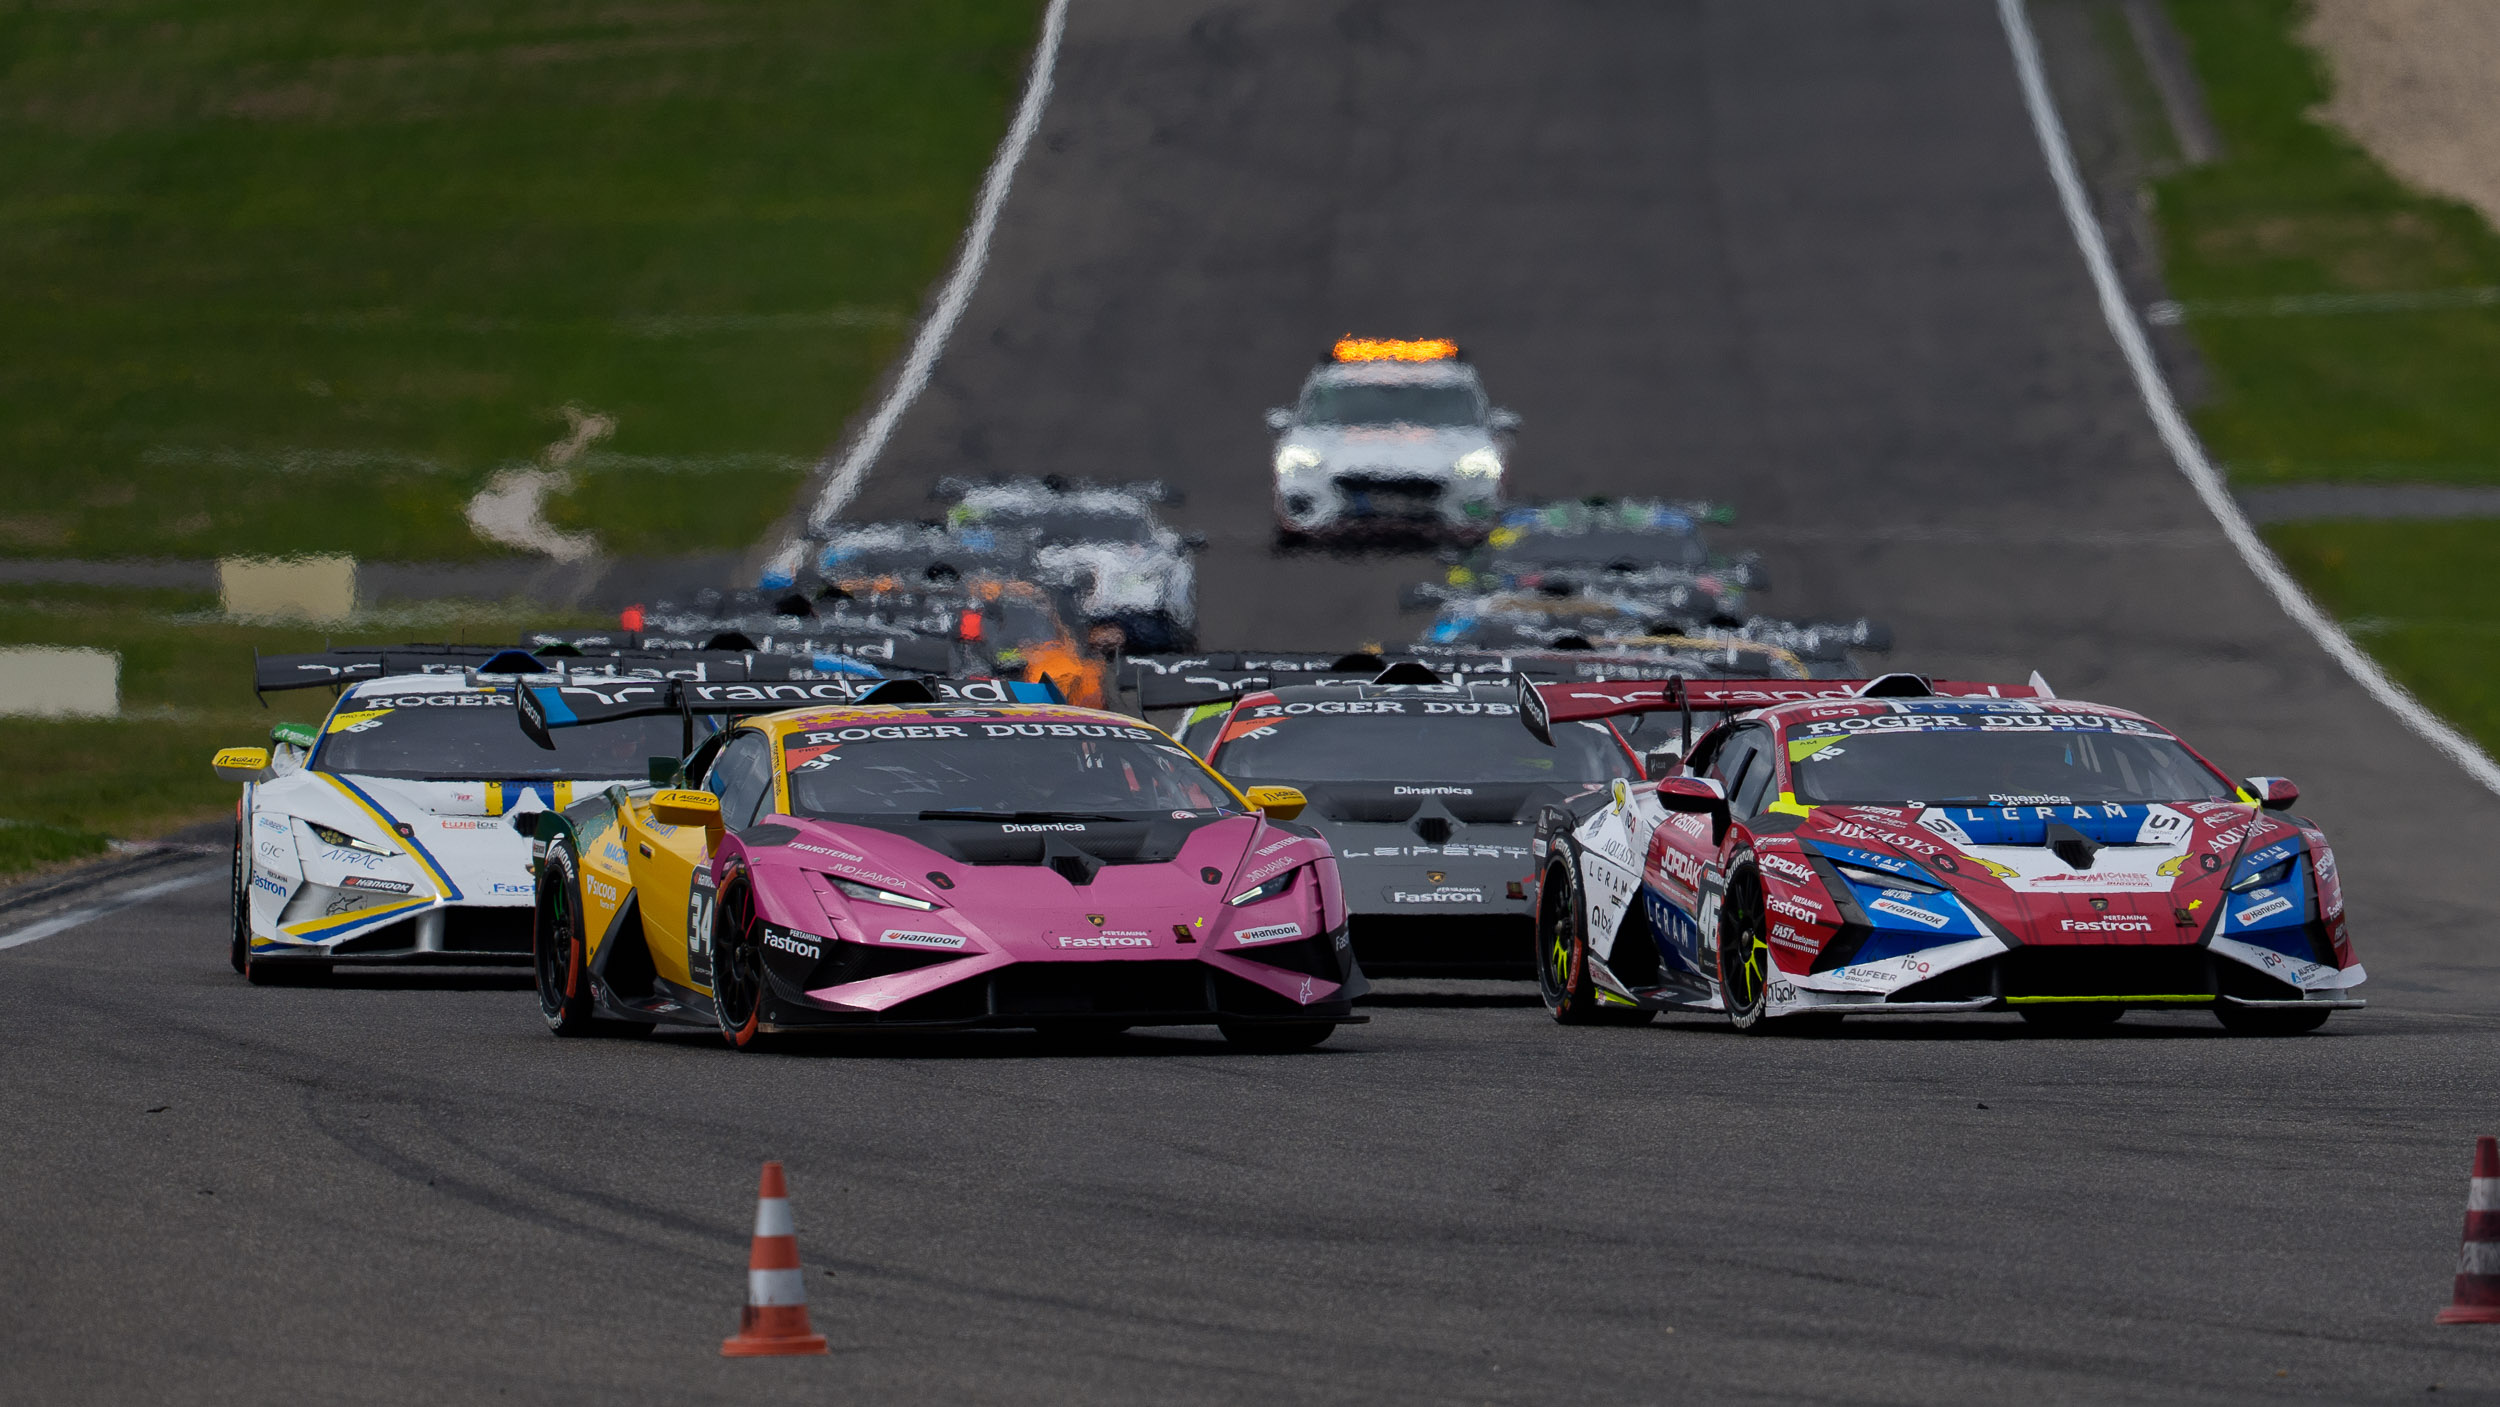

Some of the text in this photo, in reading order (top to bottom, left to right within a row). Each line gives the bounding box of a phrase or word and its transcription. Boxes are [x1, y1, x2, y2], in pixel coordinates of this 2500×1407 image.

[365, 693, 514, 709] ROGER
[1254, 701, 1520, 718] ROGER DUB
[1239, 726, 1278, 740] 70
[1806, 714, 2148, 735] ROGER DUBUIS
[805, 724, 1153, 745] ROGER DUBUIS
[801, 753, 843, 770] 34
[1811, 745, 1846, 763] 46
[678, 794, 717, 805] AGRATI
[1393, 786, 1473, 796] Dinamica
[1988, 793, 2072, 802] Dinamica
[1967, 804, 2128, 821] LERAM
[1001, 822, 1086, 834] Dinamica
[788, 841, 864, 863] TRANSTERRA
[1343, 846, 1529, 860] LEIPERT
[253, 870, 287, 898] Fastron
[1589, 861, 1628, 896] LERAM
[1393, 891, 1483, 903] Fastron
[1791, 894, 1824, 911] PERTAMINA
[1766, 894, 1818, 925] Fastron
[689, 891, 714, 957] 34
[1646, 895, 1689, 949] LERAM
[1698, 890, 1722, 953] 46
[2060, 919, 2152, 932] Fastron
[763, 928, 820, 960] Fastron
[789, 928, 822, 944] PERTAMINA
[1058, 936, 1152, 947] Fastron
[1847, 967, 1898, 982] AUFEER
